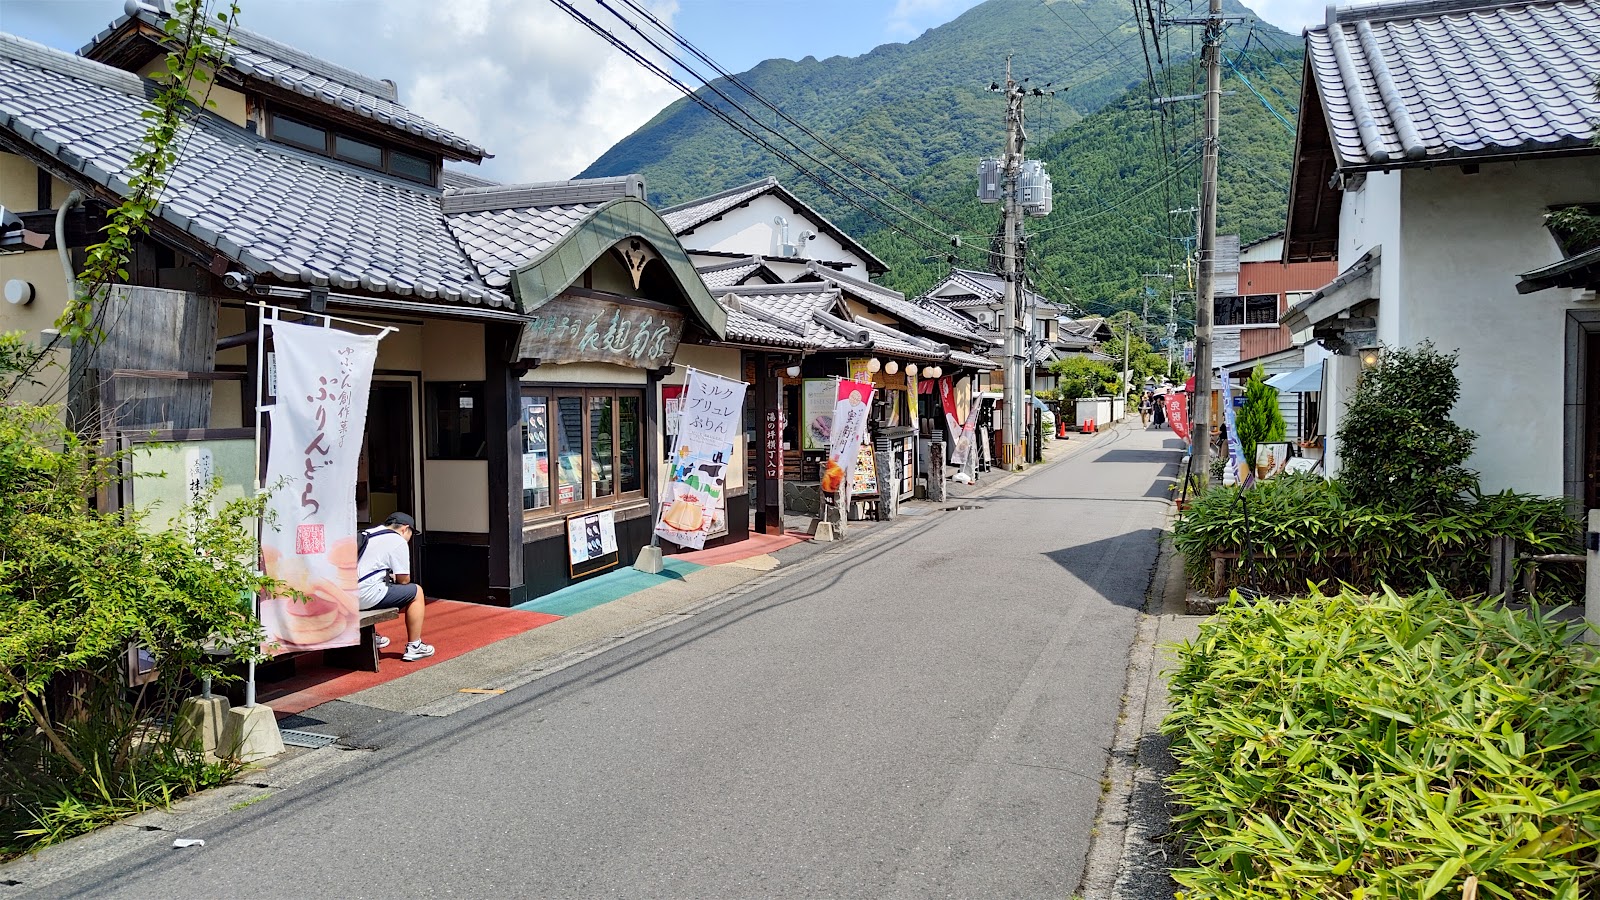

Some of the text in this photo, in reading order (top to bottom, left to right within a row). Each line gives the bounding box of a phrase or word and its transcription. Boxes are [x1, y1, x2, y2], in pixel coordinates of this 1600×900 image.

[338, 346, 355, 448] ゆふいん創作菓子
[700, 382, 733, 400] ミルク
[301, 376, 338, 521] ぷりんどら
[689, 415, 728, 434] ぷりん
[766, 411, 777, 477] 湯の坪横丁入口
